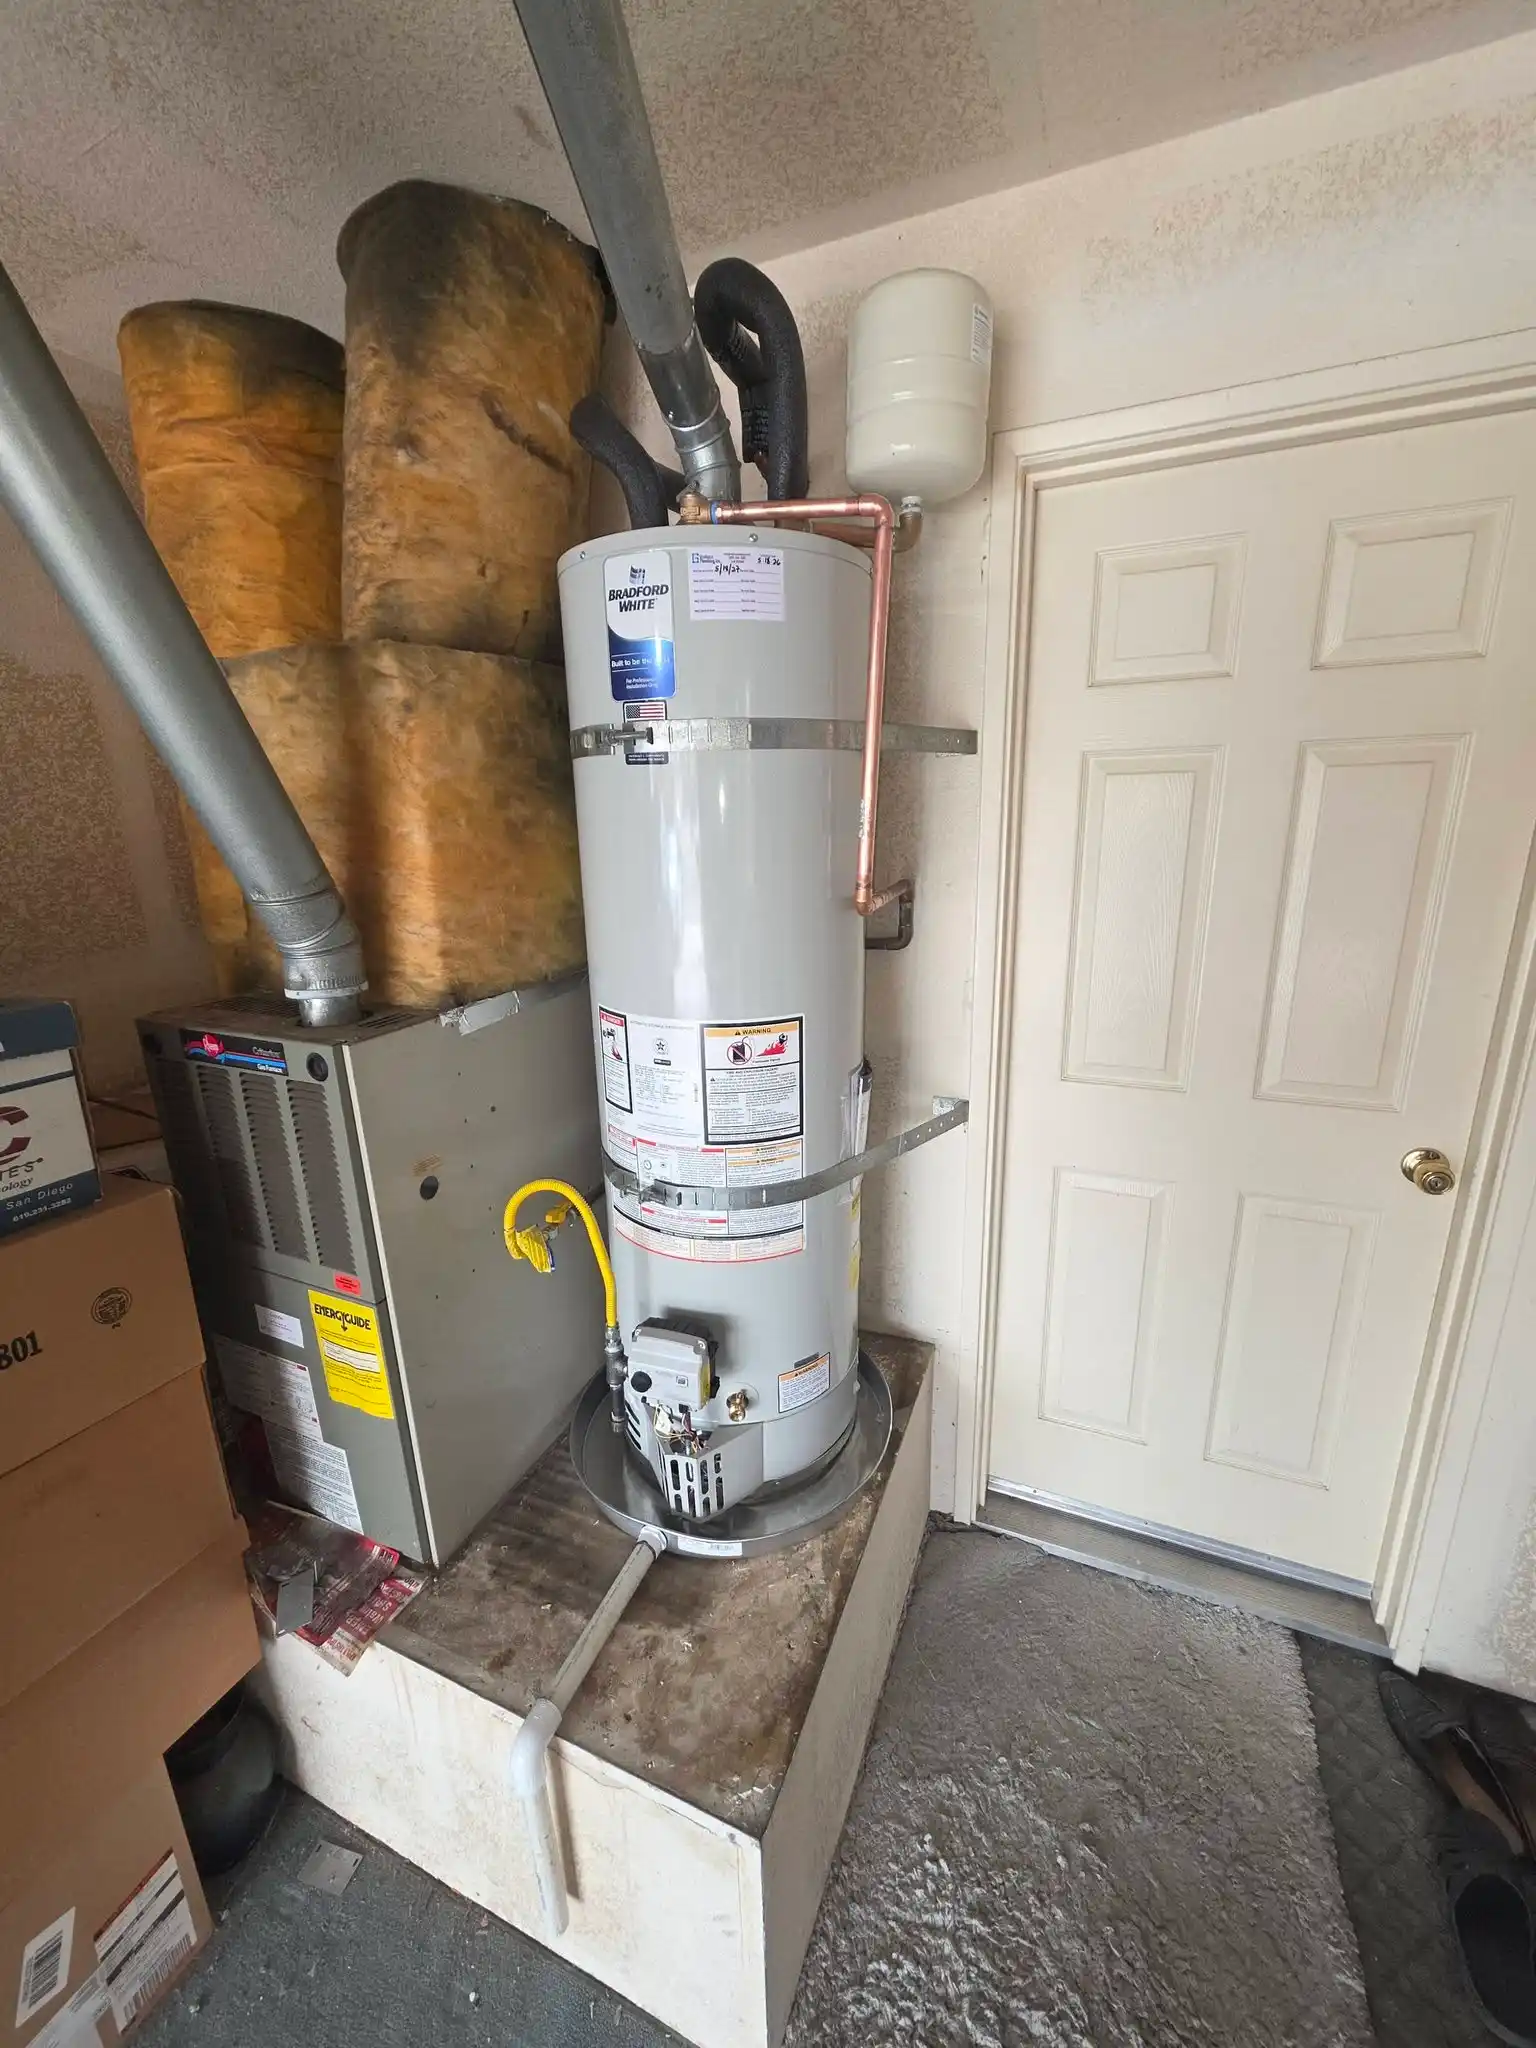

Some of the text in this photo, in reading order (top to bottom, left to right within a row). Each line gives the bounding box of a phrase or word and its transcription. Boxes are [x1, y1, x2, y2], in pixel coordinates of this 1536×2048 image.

[608, 584, 669, 602] BRADFORD
[619, 598, 656, 613] WHITE
[742, 1027, 771, 1036] WARNING
[0, 1177, 33, 1193] ology
[6, 1182, 74, 1210] San Diego
